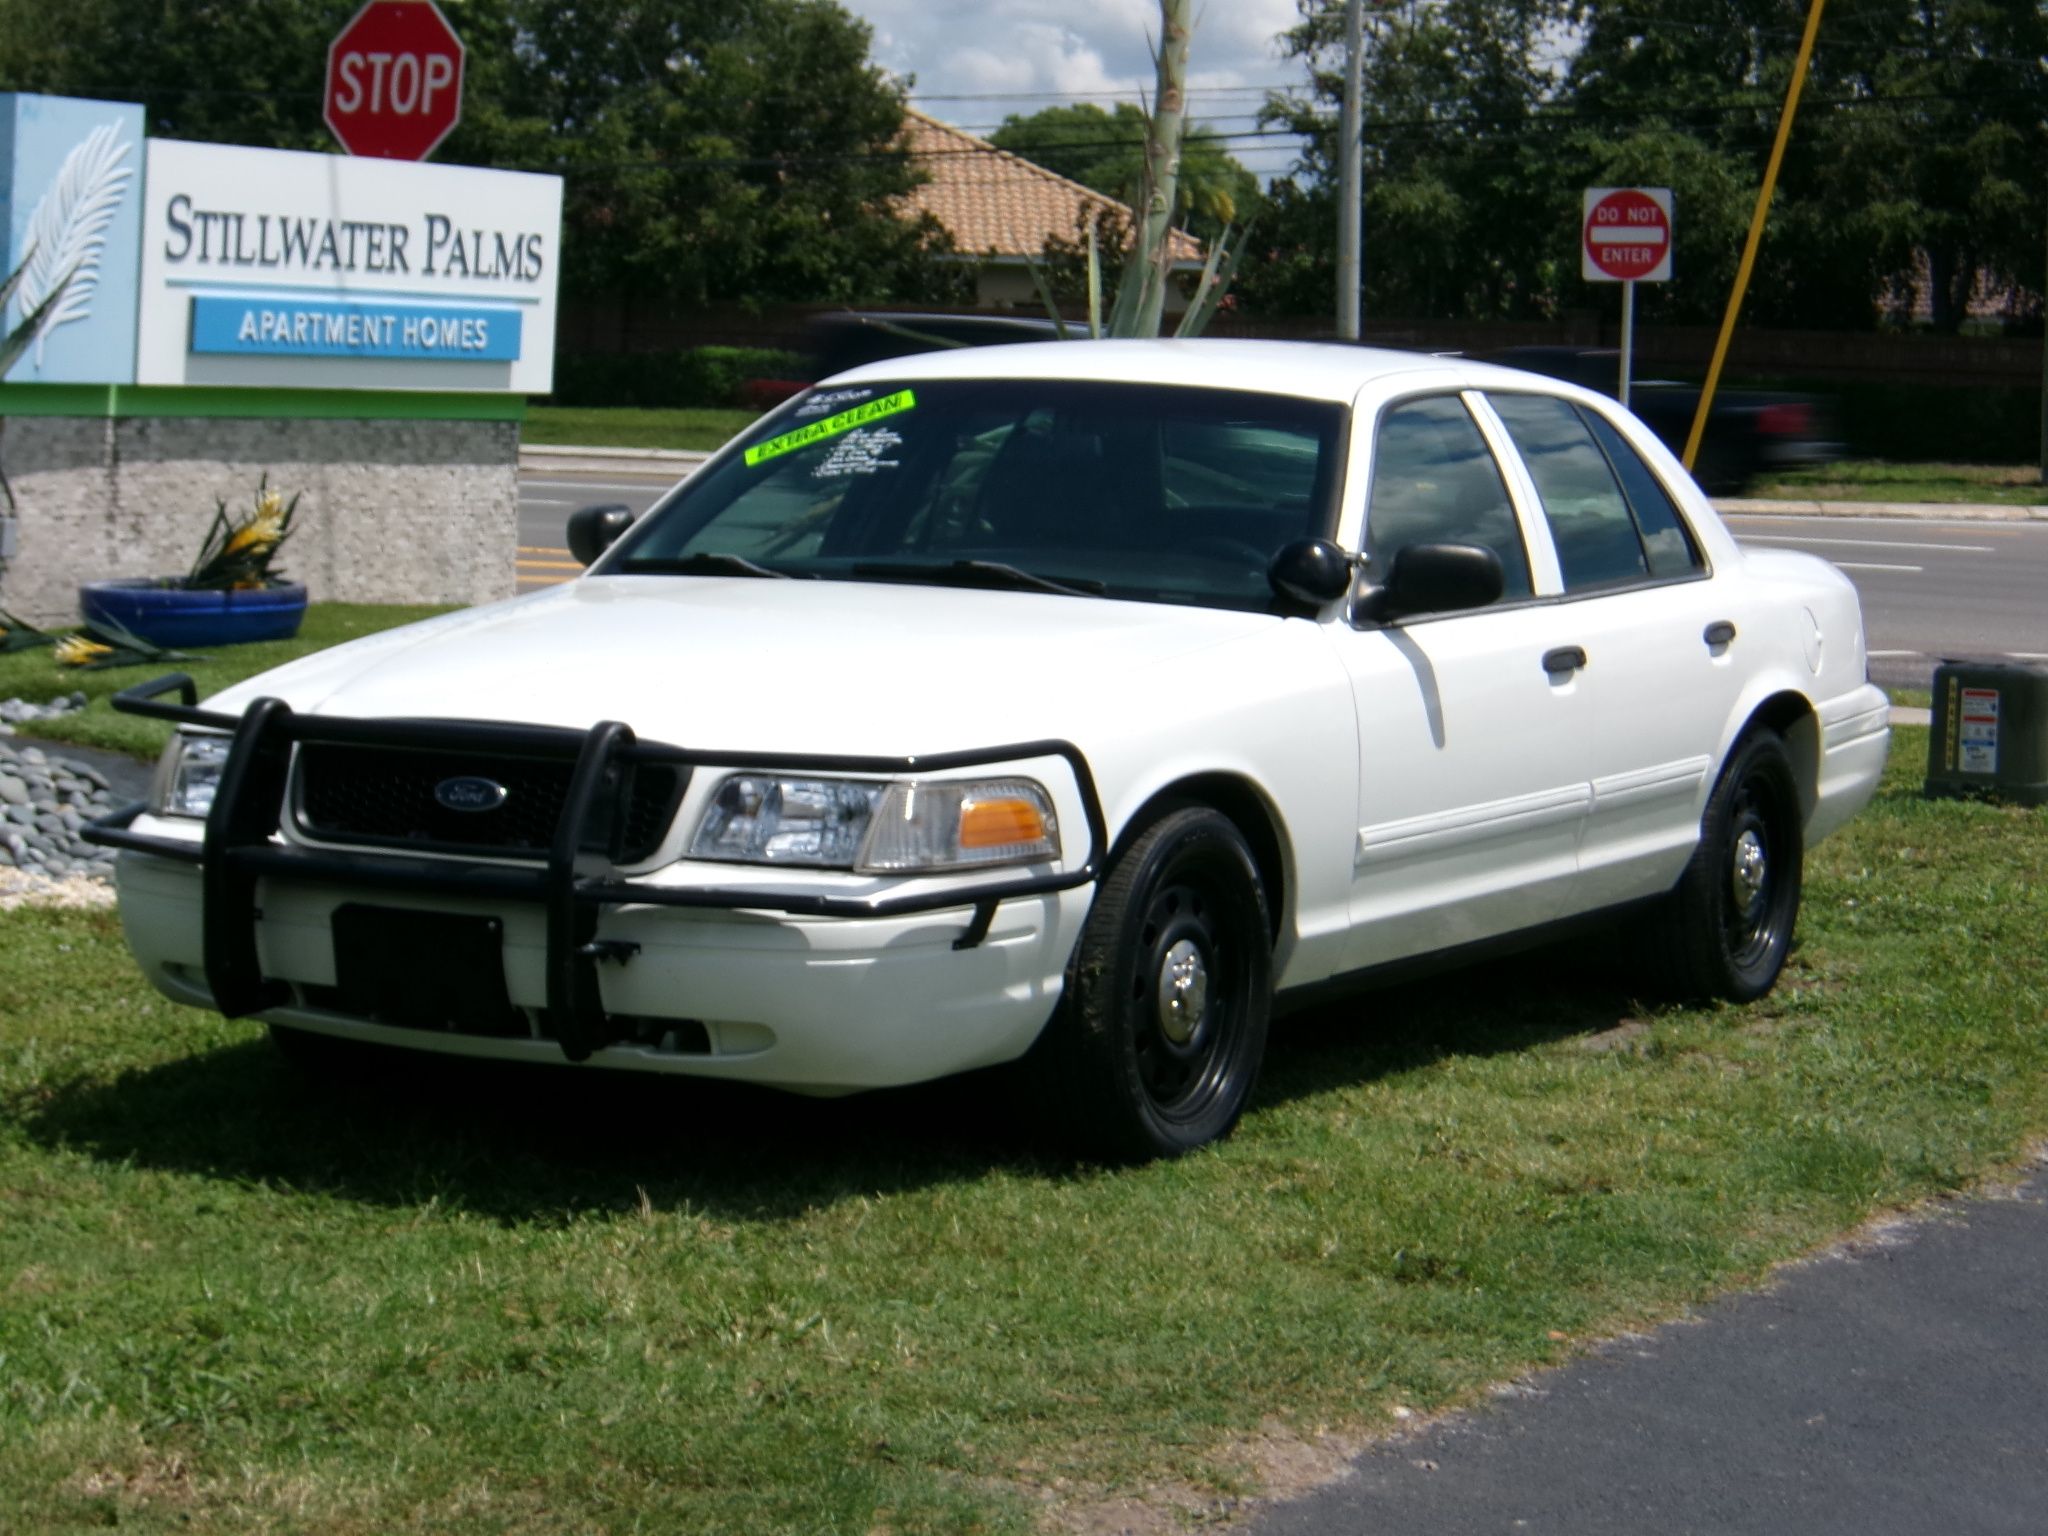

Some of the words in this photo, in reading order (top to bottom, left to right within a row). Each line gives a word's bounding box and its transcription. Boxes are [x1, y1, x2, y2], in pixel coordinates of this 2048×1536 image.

[335, 52, 453, 115] STOP
[1597, 207, 1618, 222] DO
[1627, 207, 1658, 222] NOT
[422, 212, 544, 282] PALMS
[1602, 247, 1651, 263] ENTER
[238, 310, 396, 347] APARTMENT
[402, 316, 489, 351] HOMES
[757, 422, 828, 458] EXTRA
[831, 395, 901, 430] CLEAN
[448, 784, 489, 803] Ford
